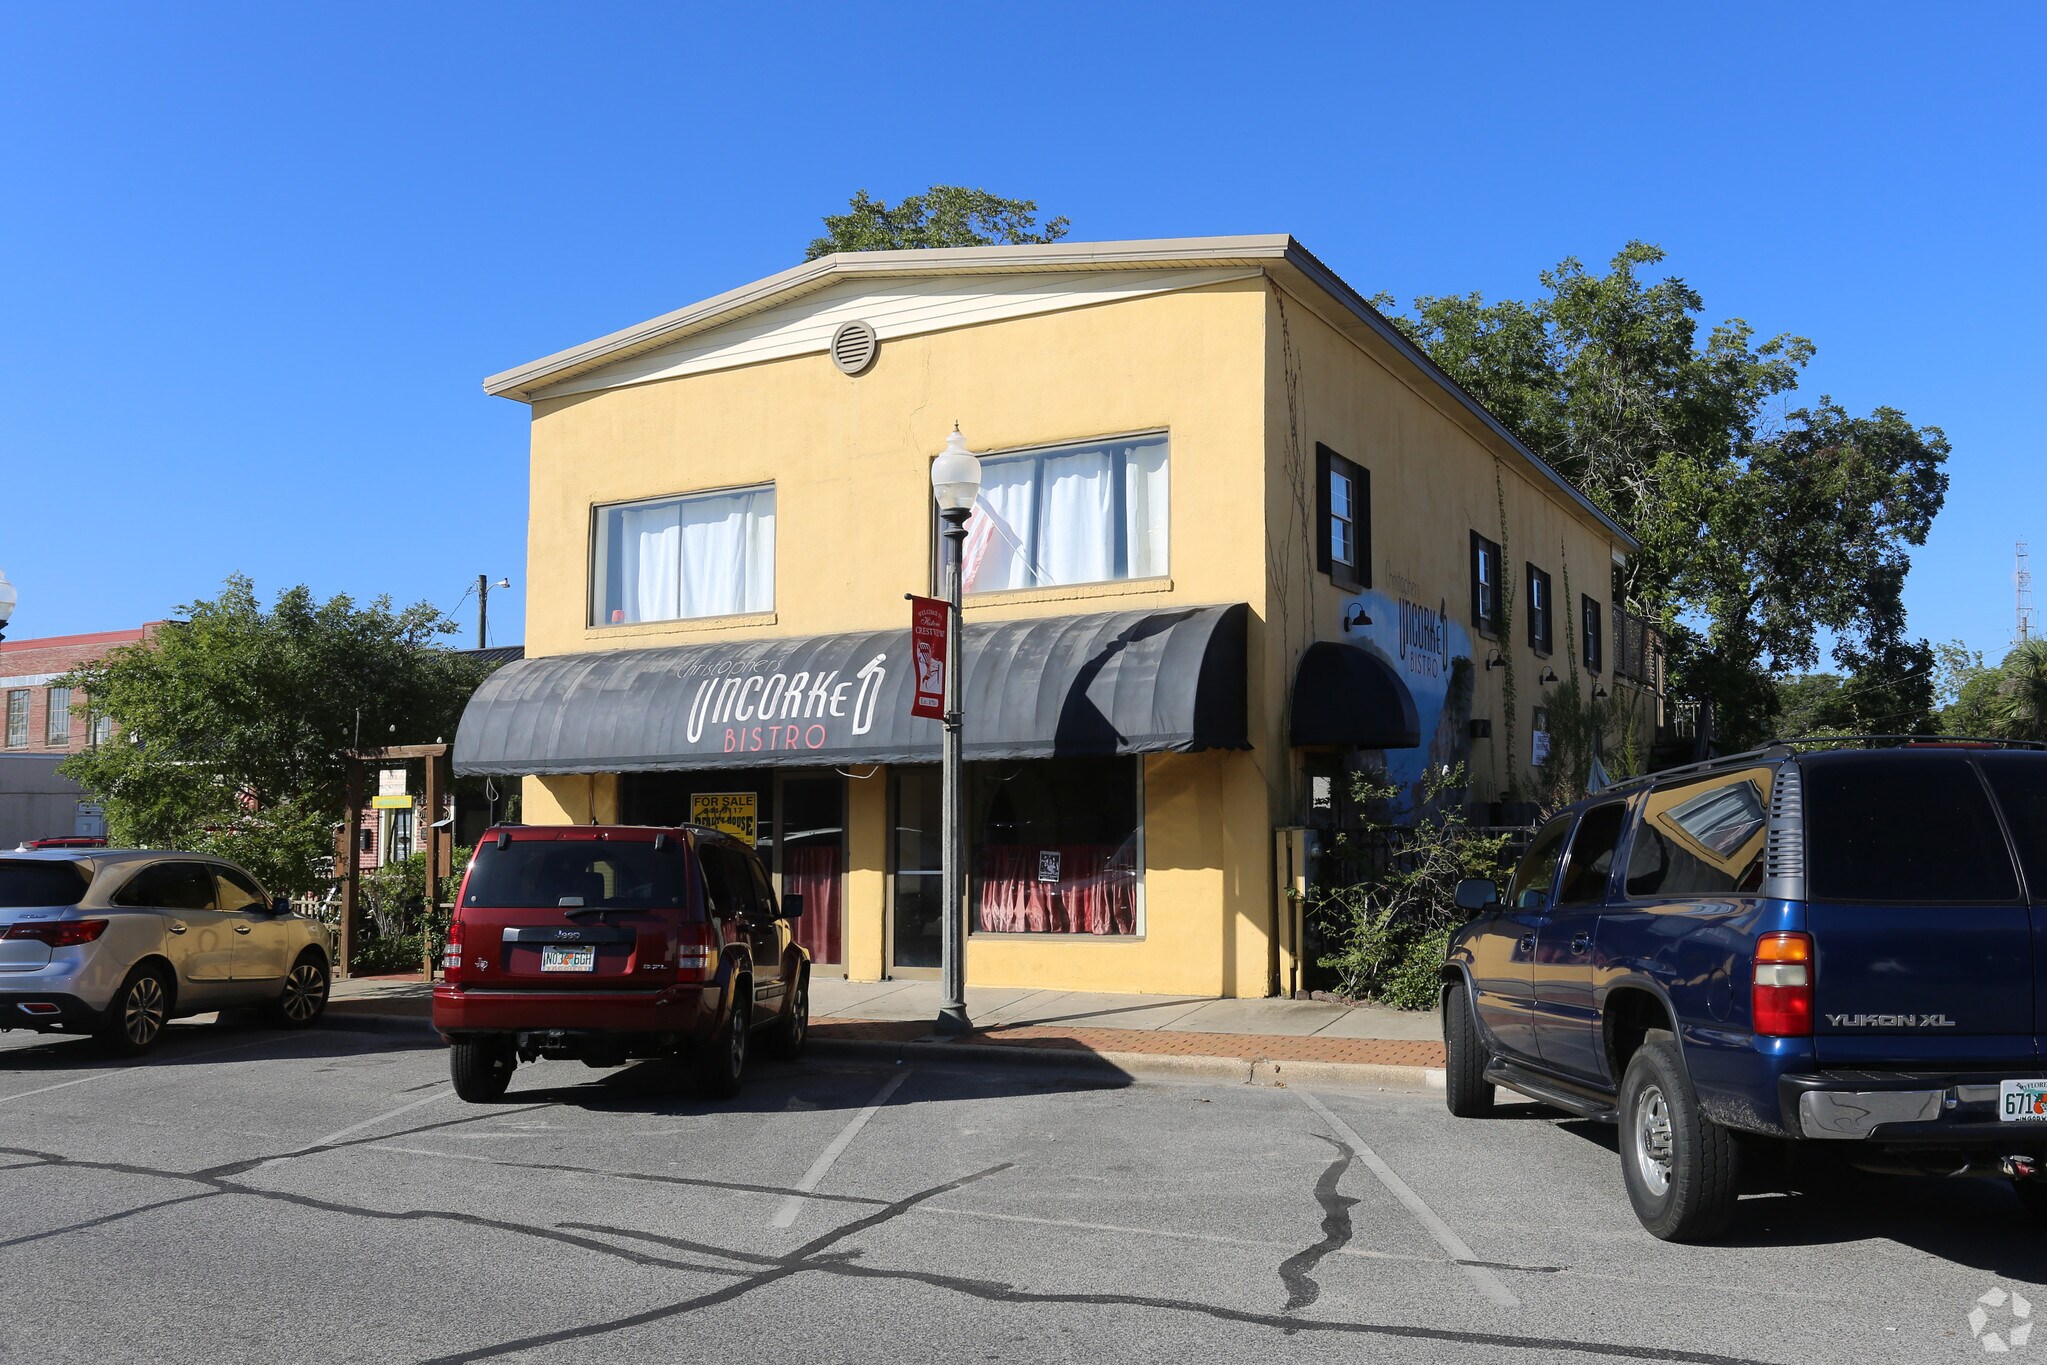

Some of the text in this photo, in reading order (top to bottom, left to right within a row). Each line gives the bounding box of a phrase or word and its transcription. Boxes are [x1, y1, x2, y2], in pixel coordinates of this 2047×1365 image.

[1410, 651, 1439, 678] BISTRO
[723, 724, 827, 753] BISTRO
[694, 796, 754, 807] FOR SALE
[554, 930, 581, 941] Jeep
[1825, 1014, 1956, 1027] YUKON XL
[2005, 1092, 2034, 1115] 671
